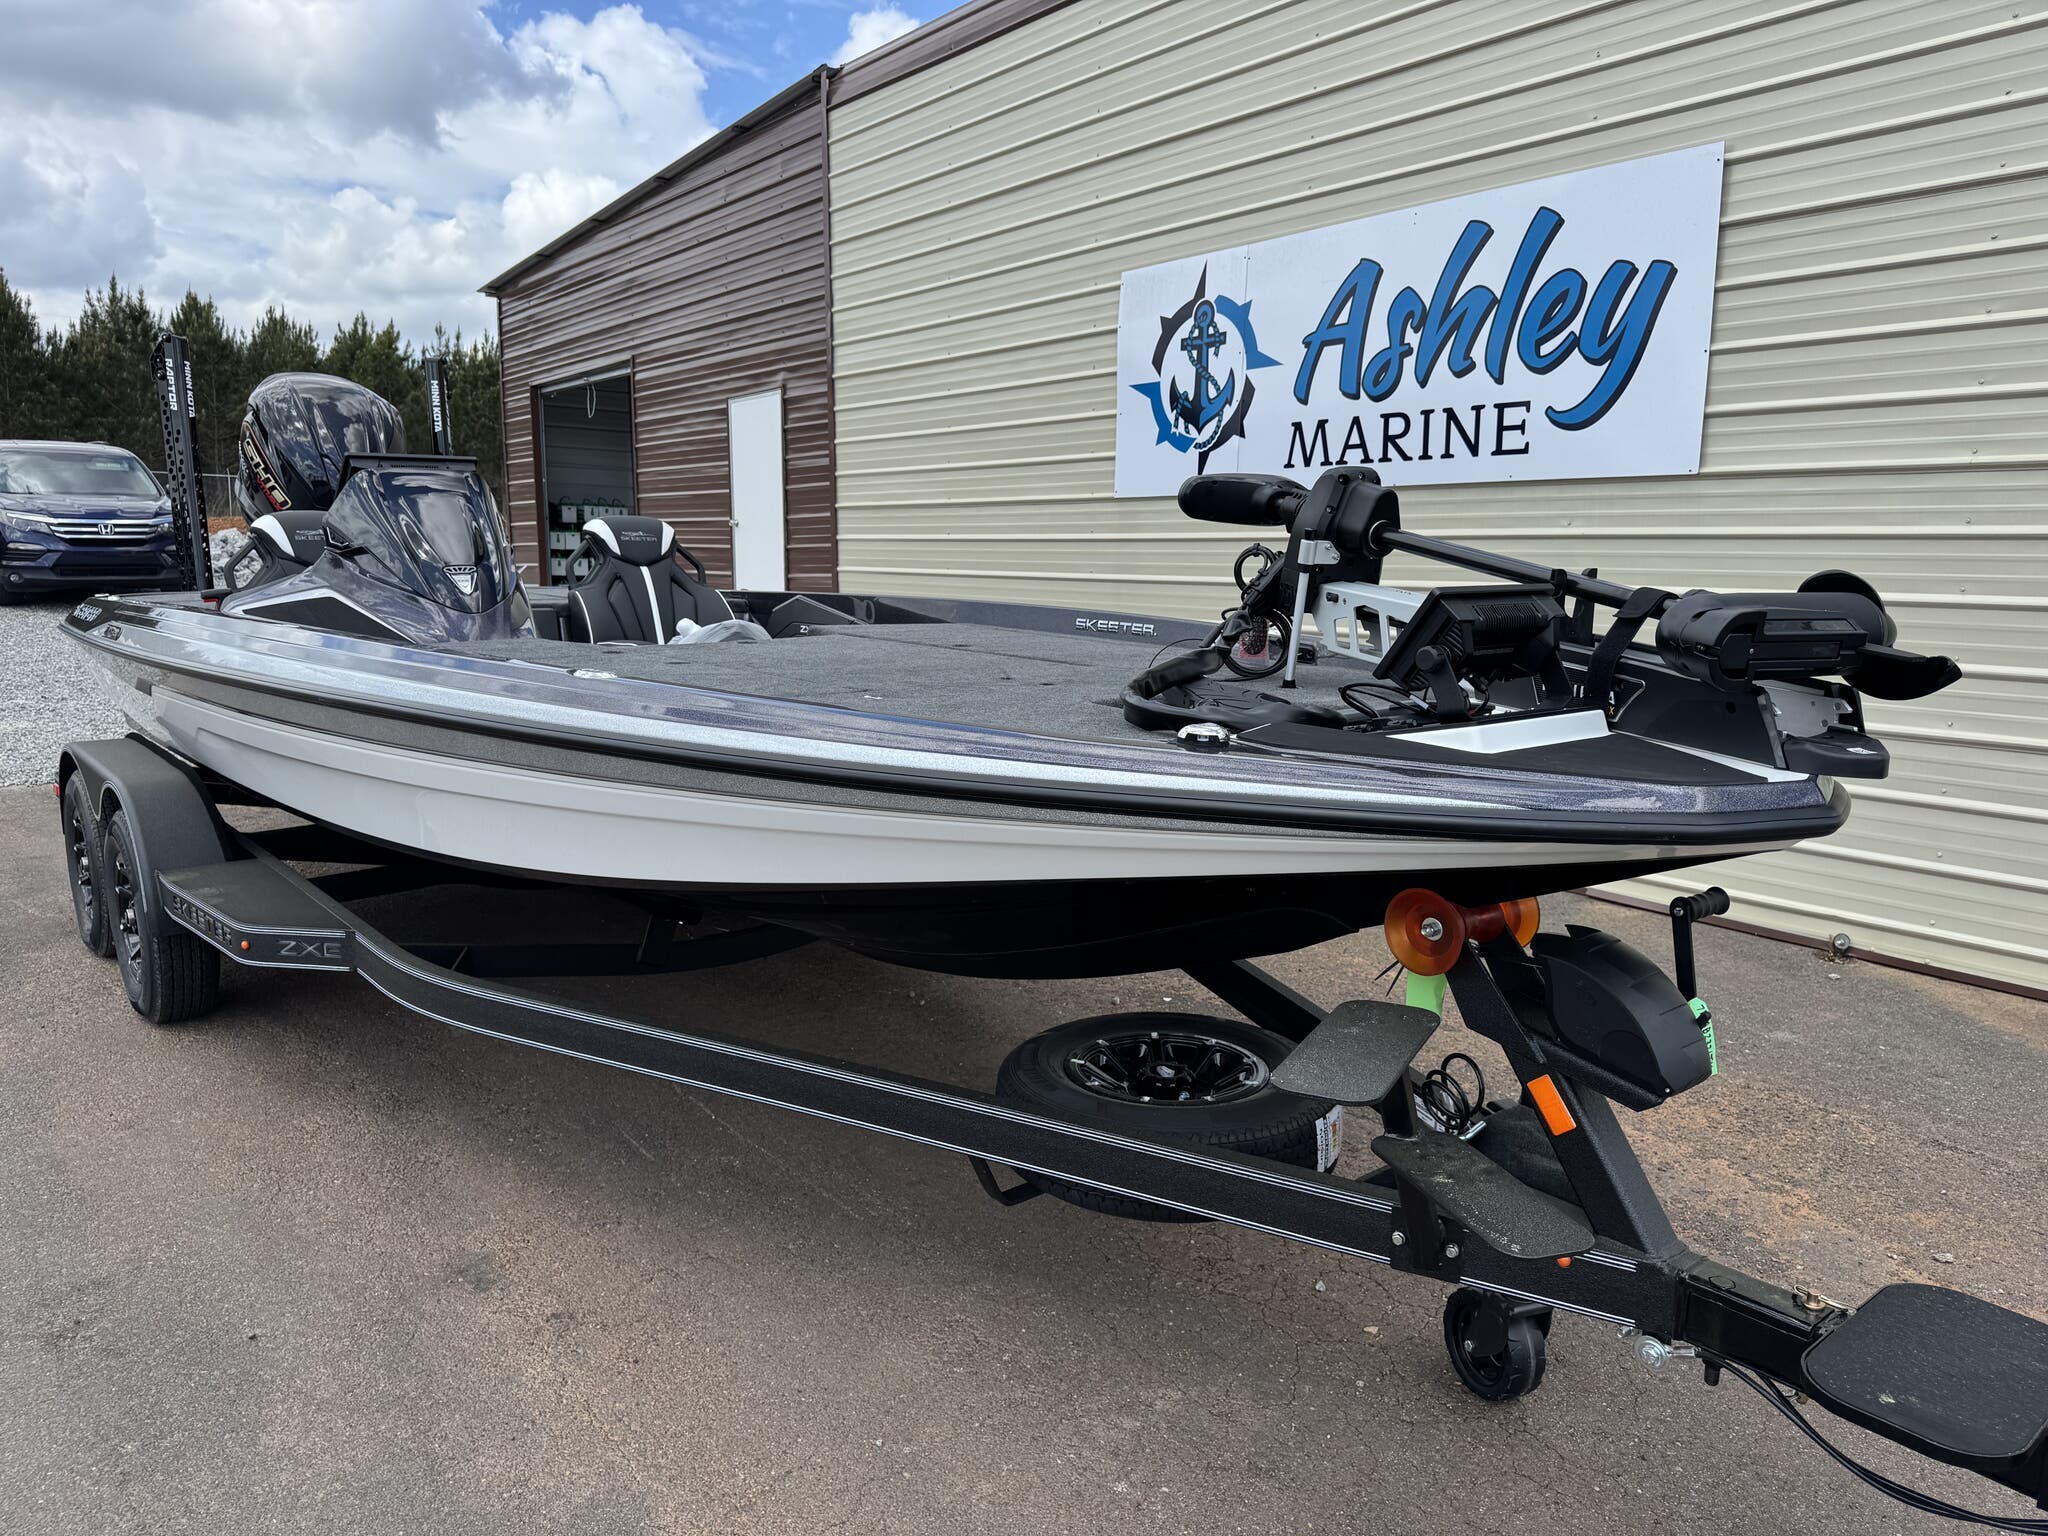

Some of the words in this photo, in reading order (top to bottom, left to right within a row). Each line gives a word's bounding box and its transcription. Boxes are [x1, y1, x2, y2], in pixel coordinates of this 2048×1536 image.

[1293, 205, 1678, 431] Ashley
[165, 358, 178, 411] RAPTOR
[183, 360, 192, 389] MINN
[186, 389, 196, 418] KOTA
[430, 379, 440, 406] MINN
[433, 406, 443, 433] KOTA
[1283, 400, 1532, 468] MARINE
[242, 438, 293, 511] SHO
[620, 535, 658, 543] SKEETER
[277, 939, 343, 959] ZXE
